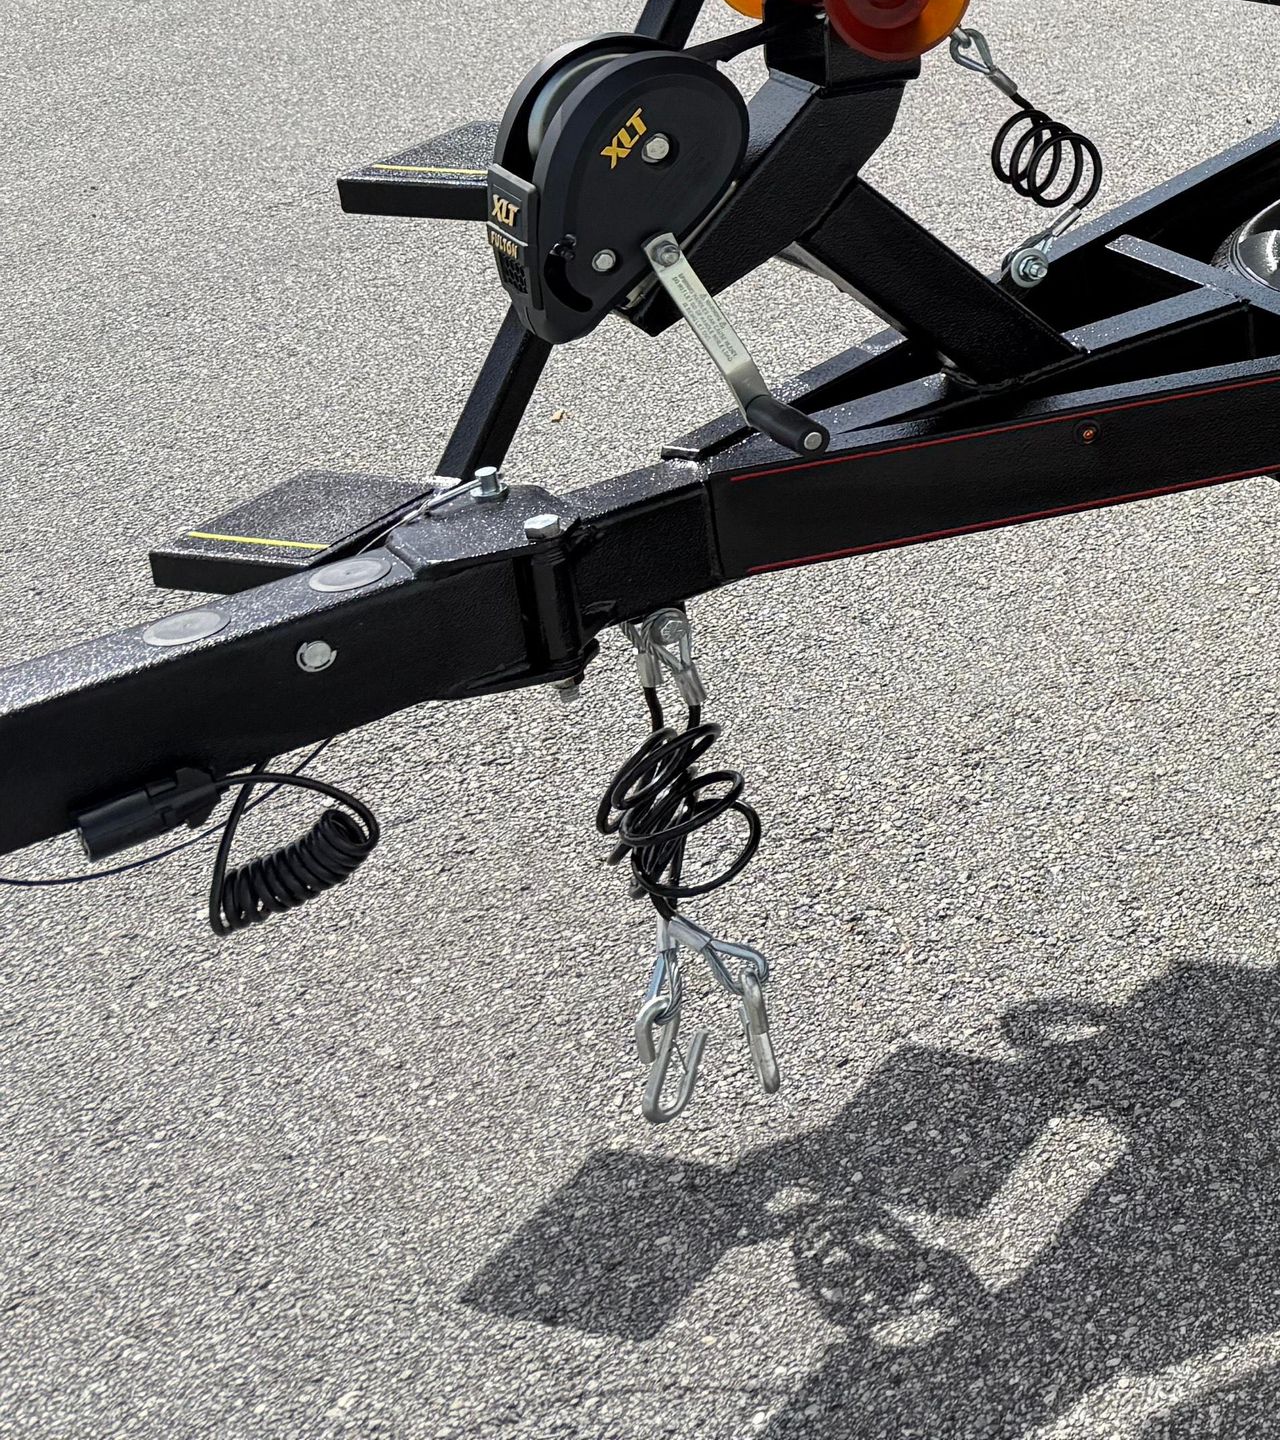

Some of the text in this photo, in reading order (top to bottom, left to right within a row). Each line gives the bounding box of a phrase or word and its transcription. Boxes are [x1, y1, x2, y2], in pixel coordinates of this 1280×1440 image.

[600, 107, 649, 170] XLT
[491, 193, 520, 227] XLT
[491, 231, 518, 259] FULTON
